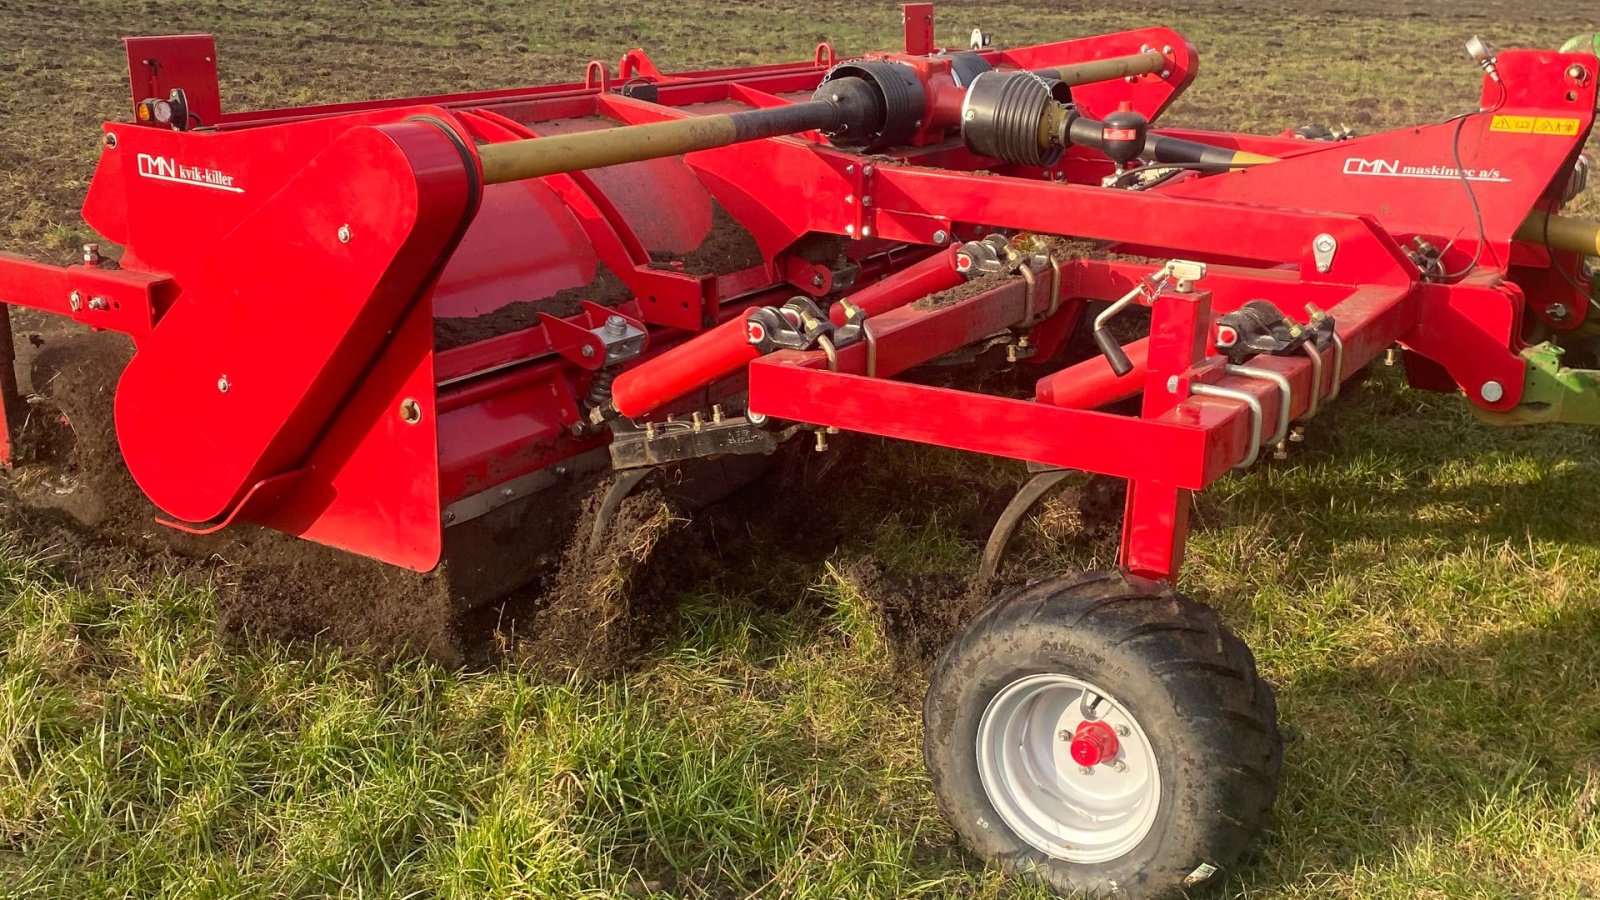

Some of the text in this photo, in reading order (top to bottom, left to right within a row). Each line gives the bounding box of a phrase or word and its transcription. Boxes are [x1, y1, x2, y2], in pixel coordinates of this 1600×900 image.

[138, 153, 234, 186] CMN kvik-killer
[1343, 158, 1399, 174] CMN
[1479, 167, 1500, 178] a/s
